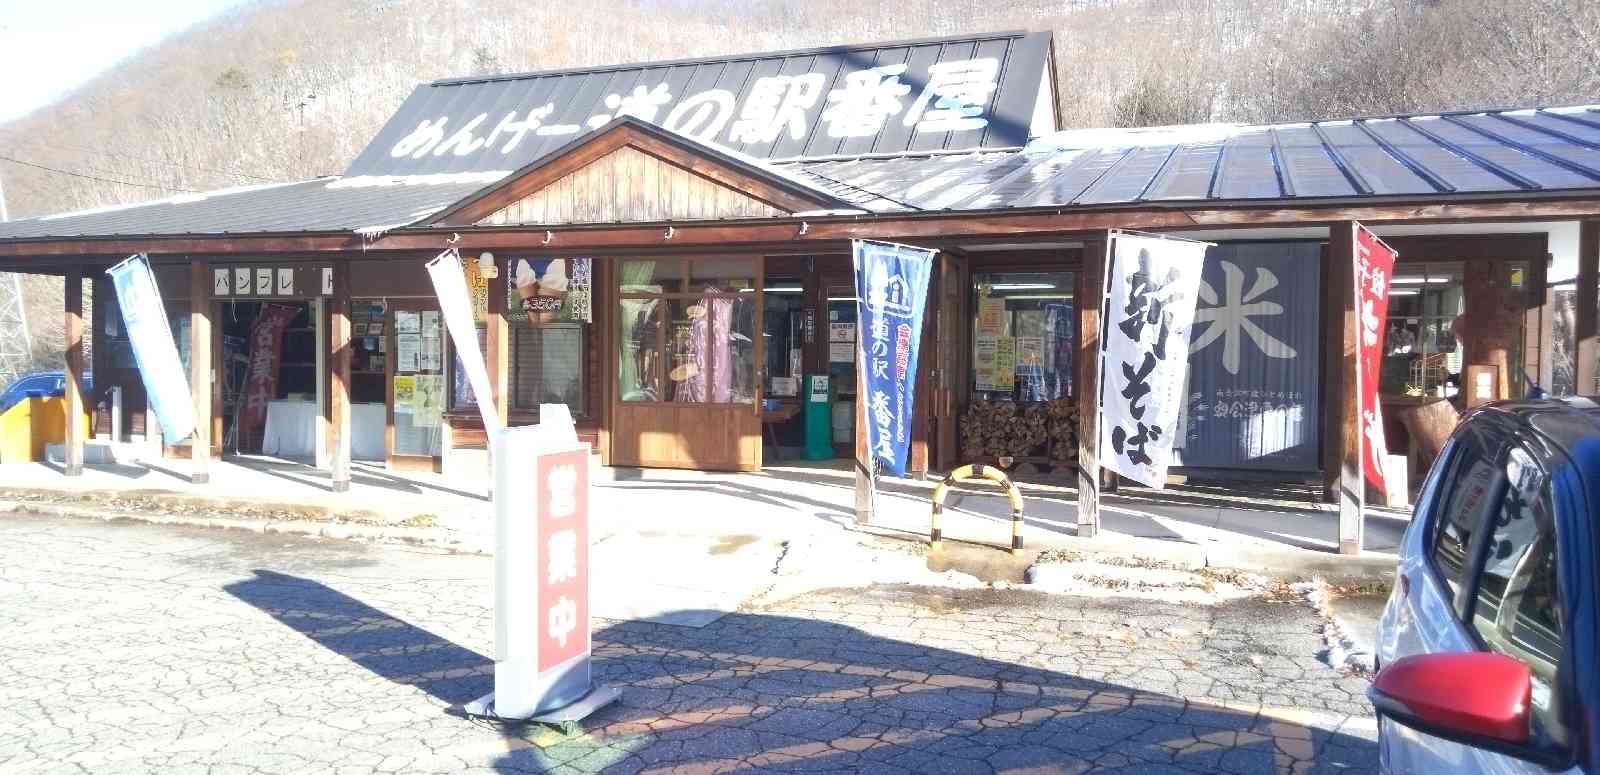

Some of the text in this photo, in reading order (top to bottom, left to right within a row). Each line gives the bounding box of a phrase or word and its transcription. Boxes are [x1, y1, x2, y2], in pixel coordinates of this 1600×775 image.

[1112, 247, 1184, 466] 新そば
[1189, 260, 1297, 374] 米
[871, 390, 896, 467] 番屋
[547, 463, 578, 649] 営業中
